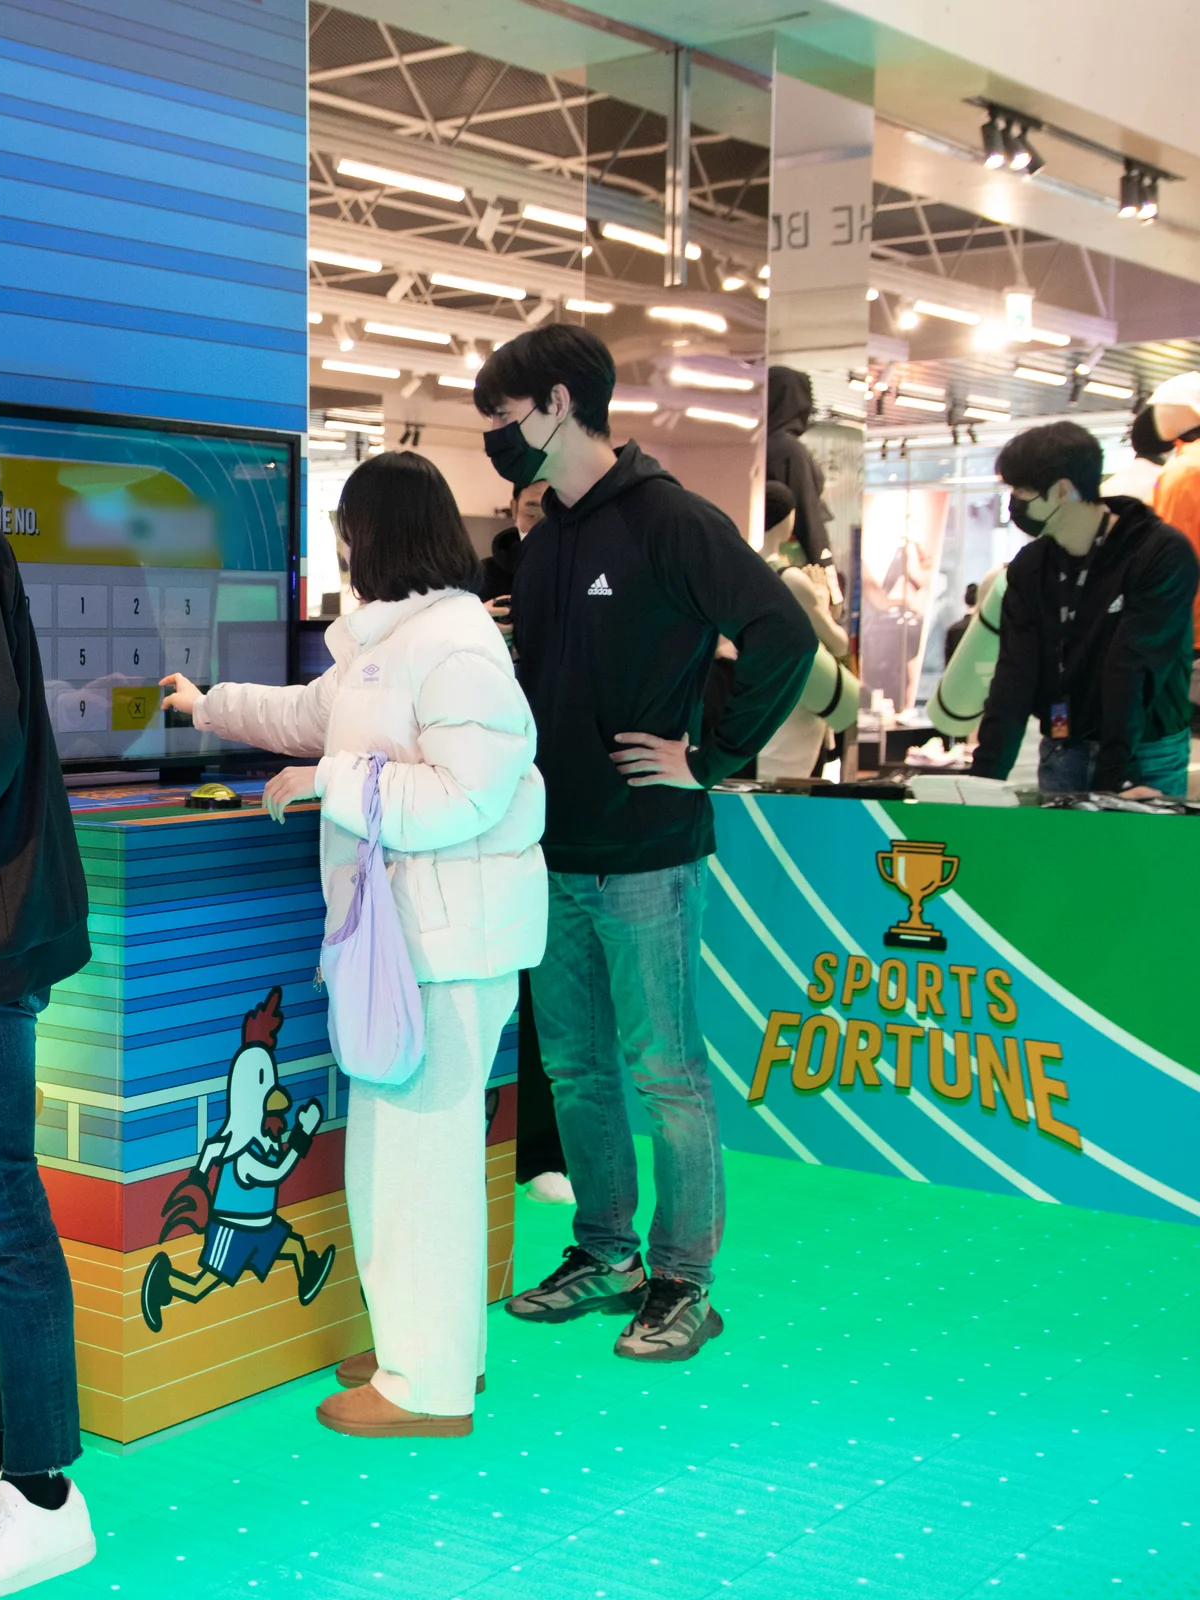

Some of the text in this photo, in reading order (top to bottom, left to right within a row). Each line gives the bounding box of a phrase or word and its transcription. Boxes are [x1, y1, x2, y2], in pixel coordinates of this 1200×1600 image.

[14, 507, 40, 536] NO.
[80, 596, 191, 616] 1 2 3
[79, 647, 191, 666] 5 6 7
[79, 700, 86, 718] 9
[807, 951, 1019, 1024] SPORTS
[747, 1009, 1083, 1151] FORTUNE
